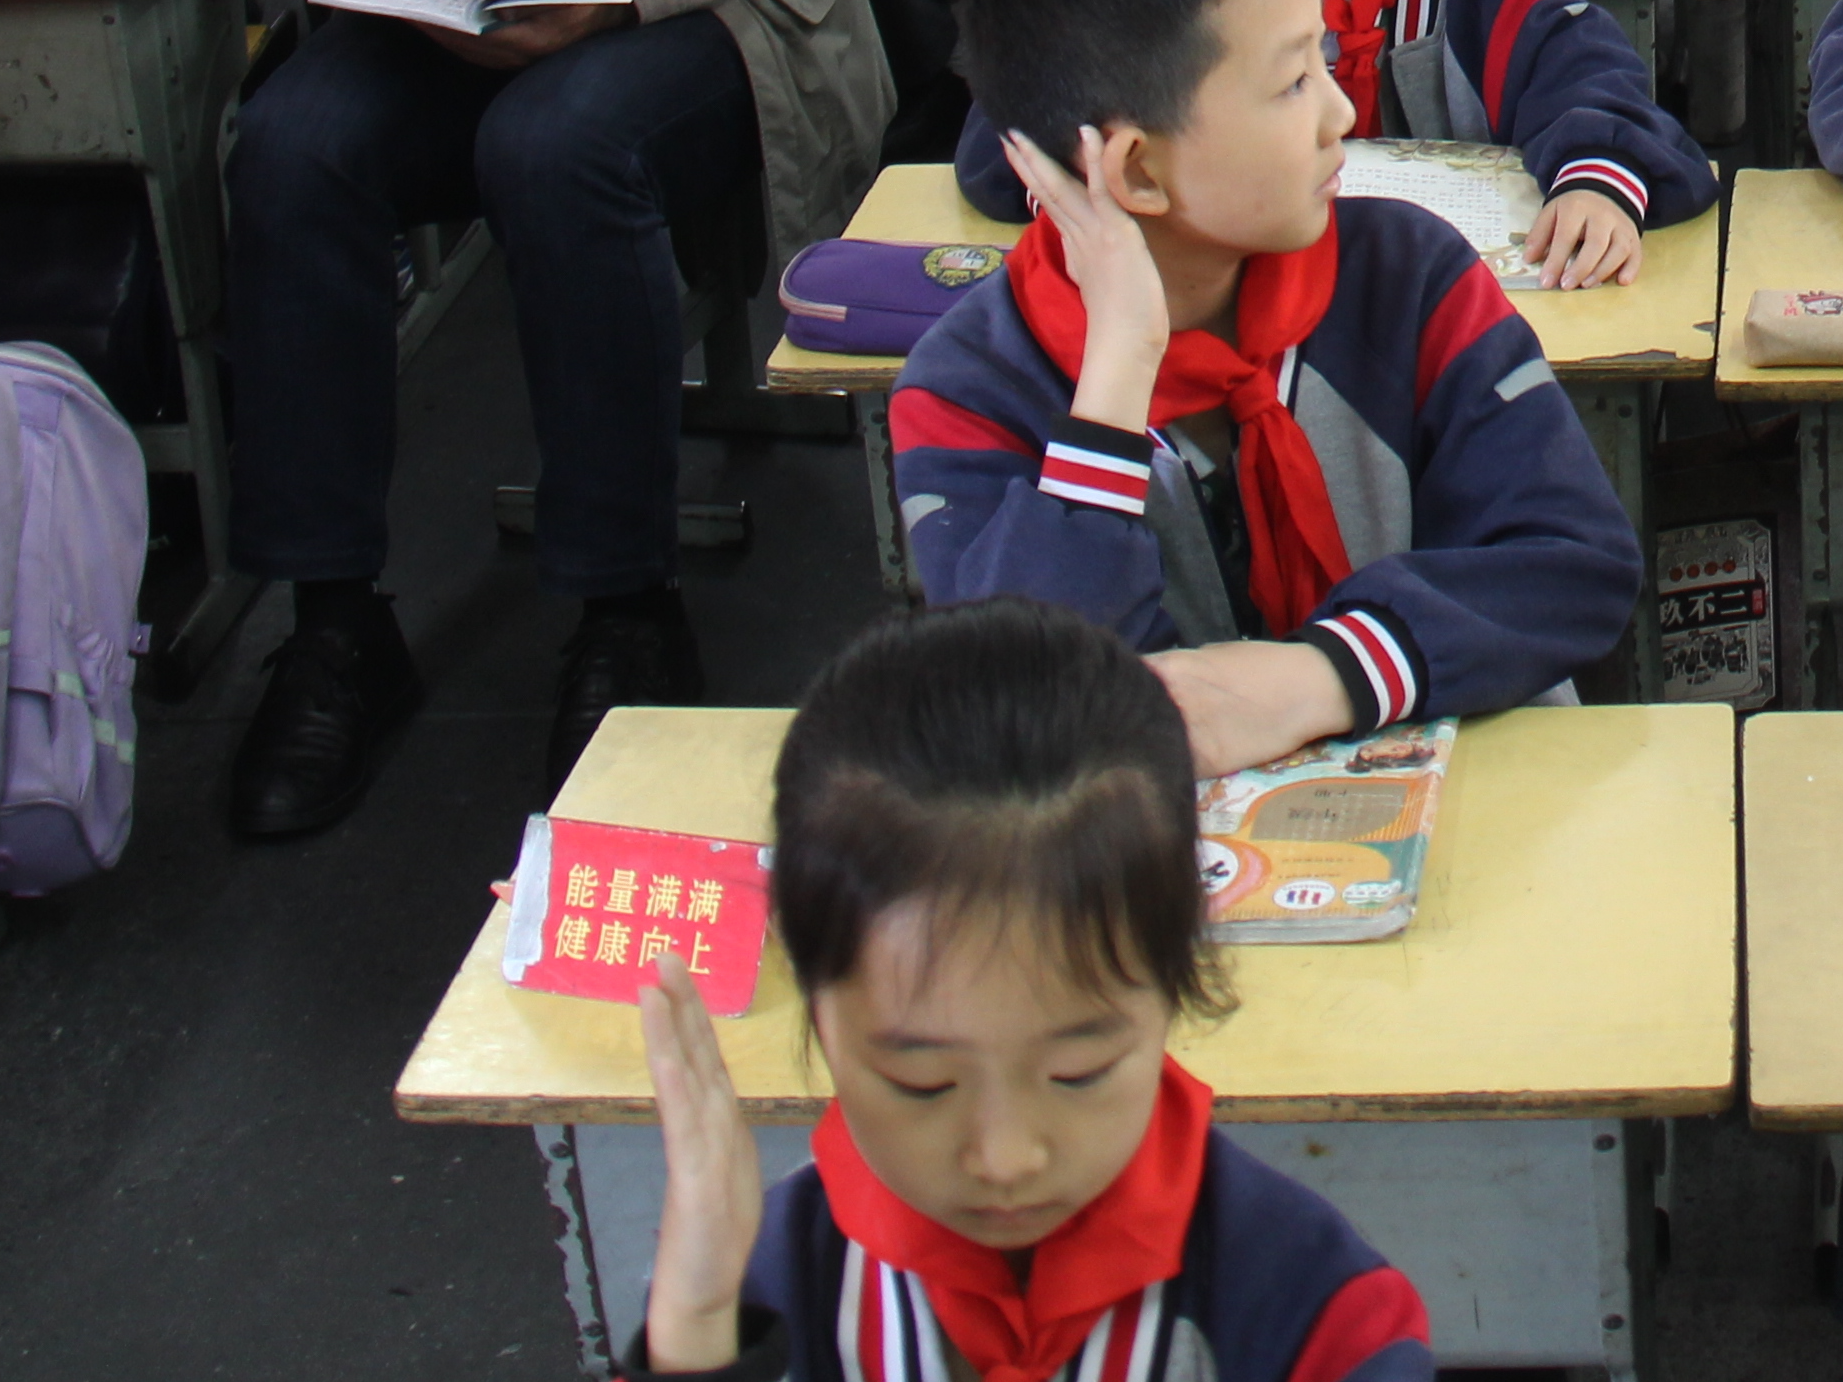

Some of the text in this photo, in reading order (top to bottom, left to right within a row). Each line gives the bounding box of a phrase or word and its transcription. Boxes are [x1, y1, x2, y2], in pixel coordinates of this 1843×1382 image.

[565, 863, 723, 924] 能量满满
[554, 915, 711, 975] 健康向上
